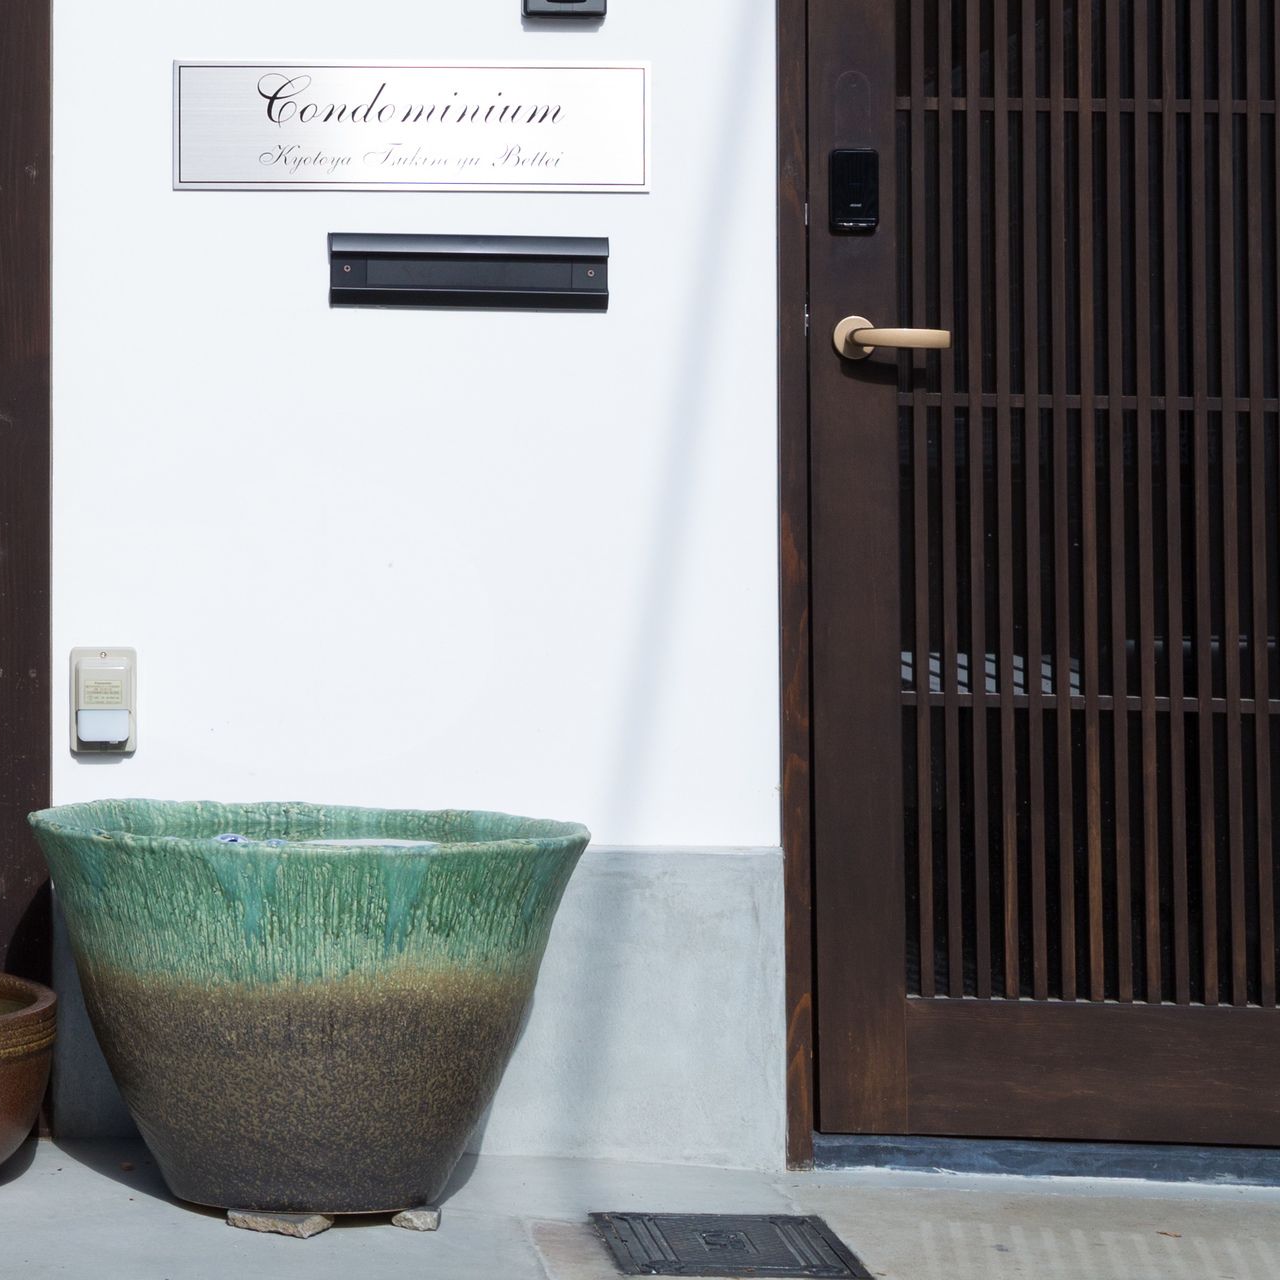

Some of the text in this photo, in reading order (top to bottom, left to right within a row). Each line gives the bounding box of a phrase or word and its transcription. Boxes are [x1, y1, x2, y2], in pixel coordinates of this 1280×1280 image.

[257, 72, 565, 128] Condominium
[258, 143, 352, 175] Kyotoya
[492, 143, 564, 168] Bettei
